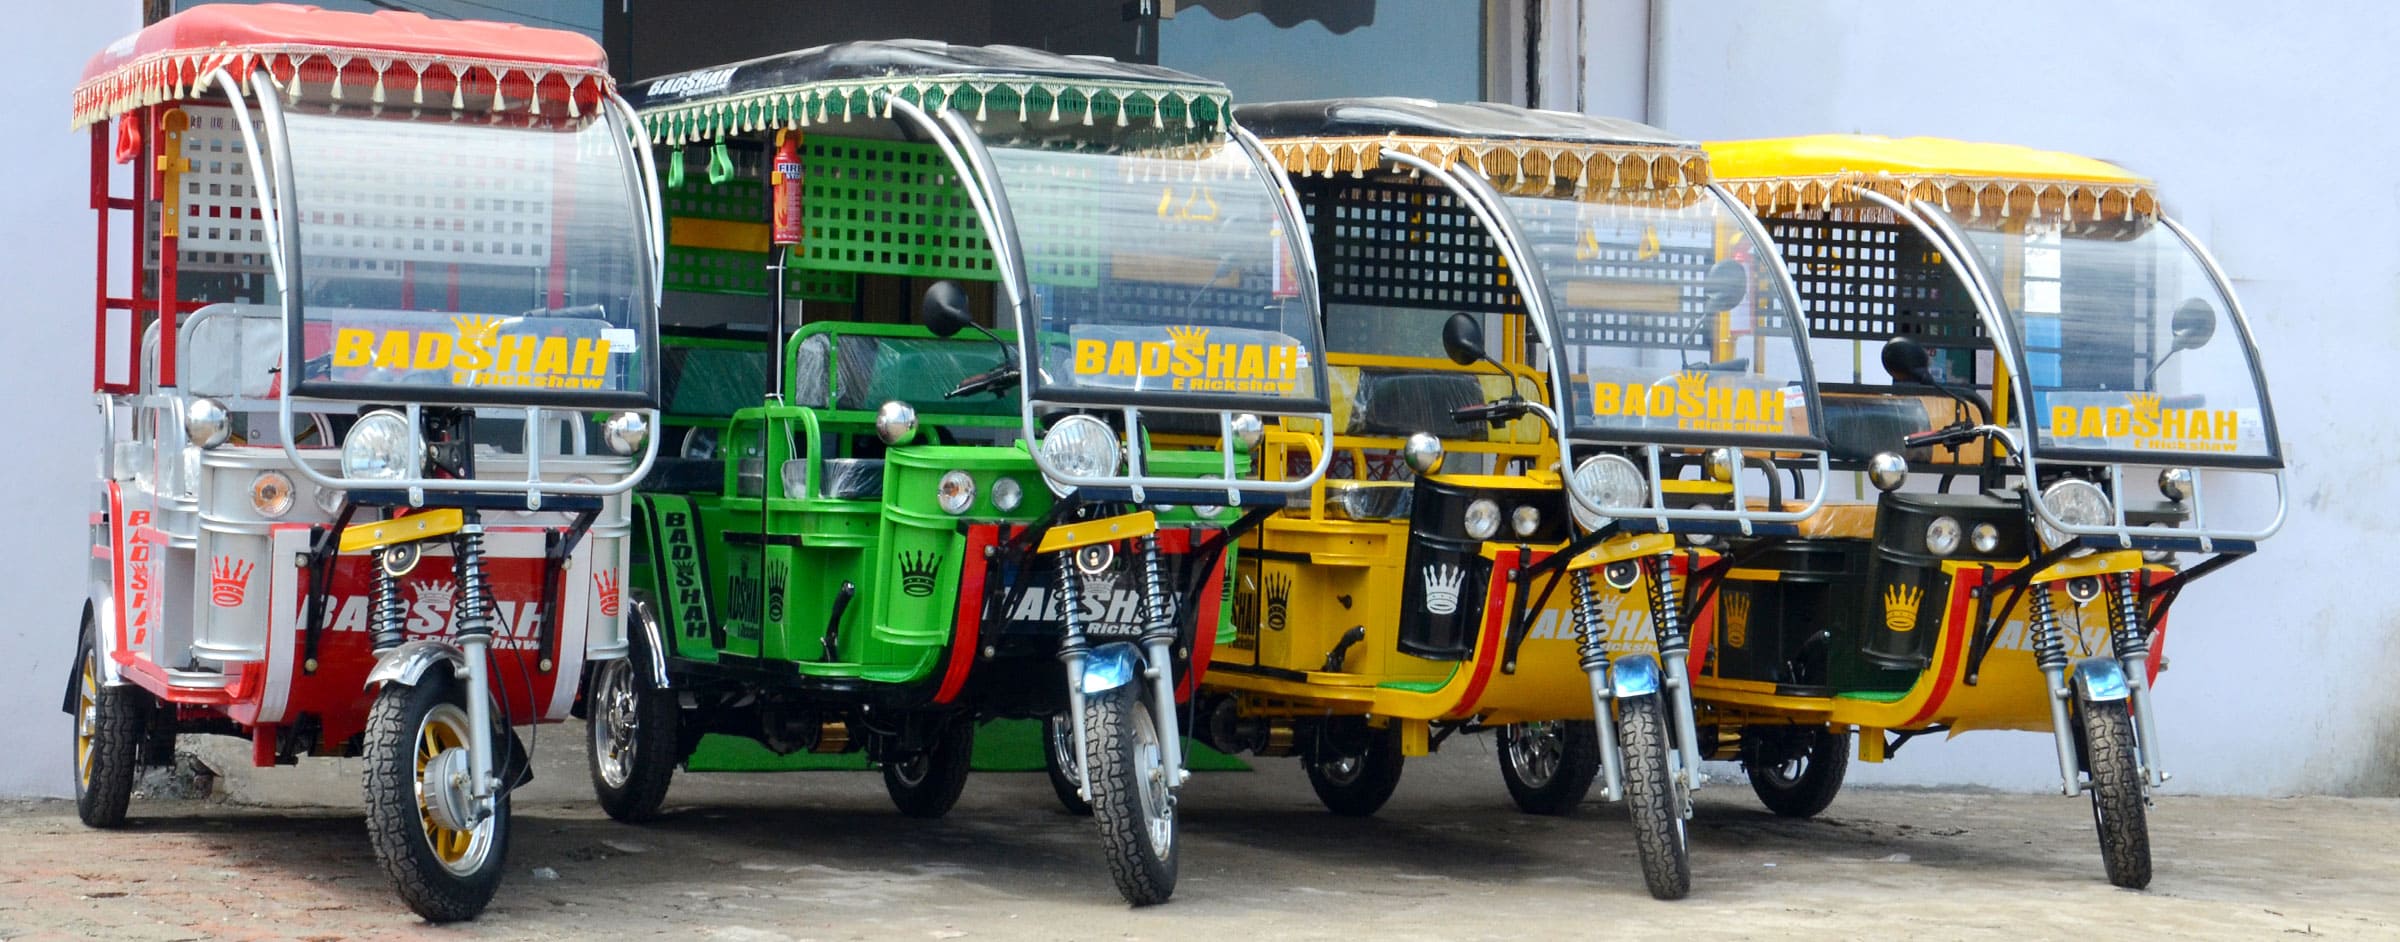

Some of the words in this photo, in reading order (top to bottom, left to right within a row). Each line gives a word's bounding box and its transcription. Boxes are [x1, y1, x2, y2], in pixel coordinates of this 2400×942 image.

[332, 328, 611, 377] BADSHAH
[1074, 339, 1298, 380] BADSHAH
[452, 371, 467, 385] E
[474, 371, 604, 390] Rickshaw
[1172, 377, 1185, 390] E
[1190, 377, 1296, 393] Rickshaw
[1594, 382, 1785, 422] BADSHAH
[1678, 418, 1688, 431] E
[1693, 419, 1784, 433] Rickshaw
[2052, 406, 2238, 441] BADSHAH
[2148, 439, 2237, 452] Rickshaw
[665, 512, 708, 638] BADSHAH
